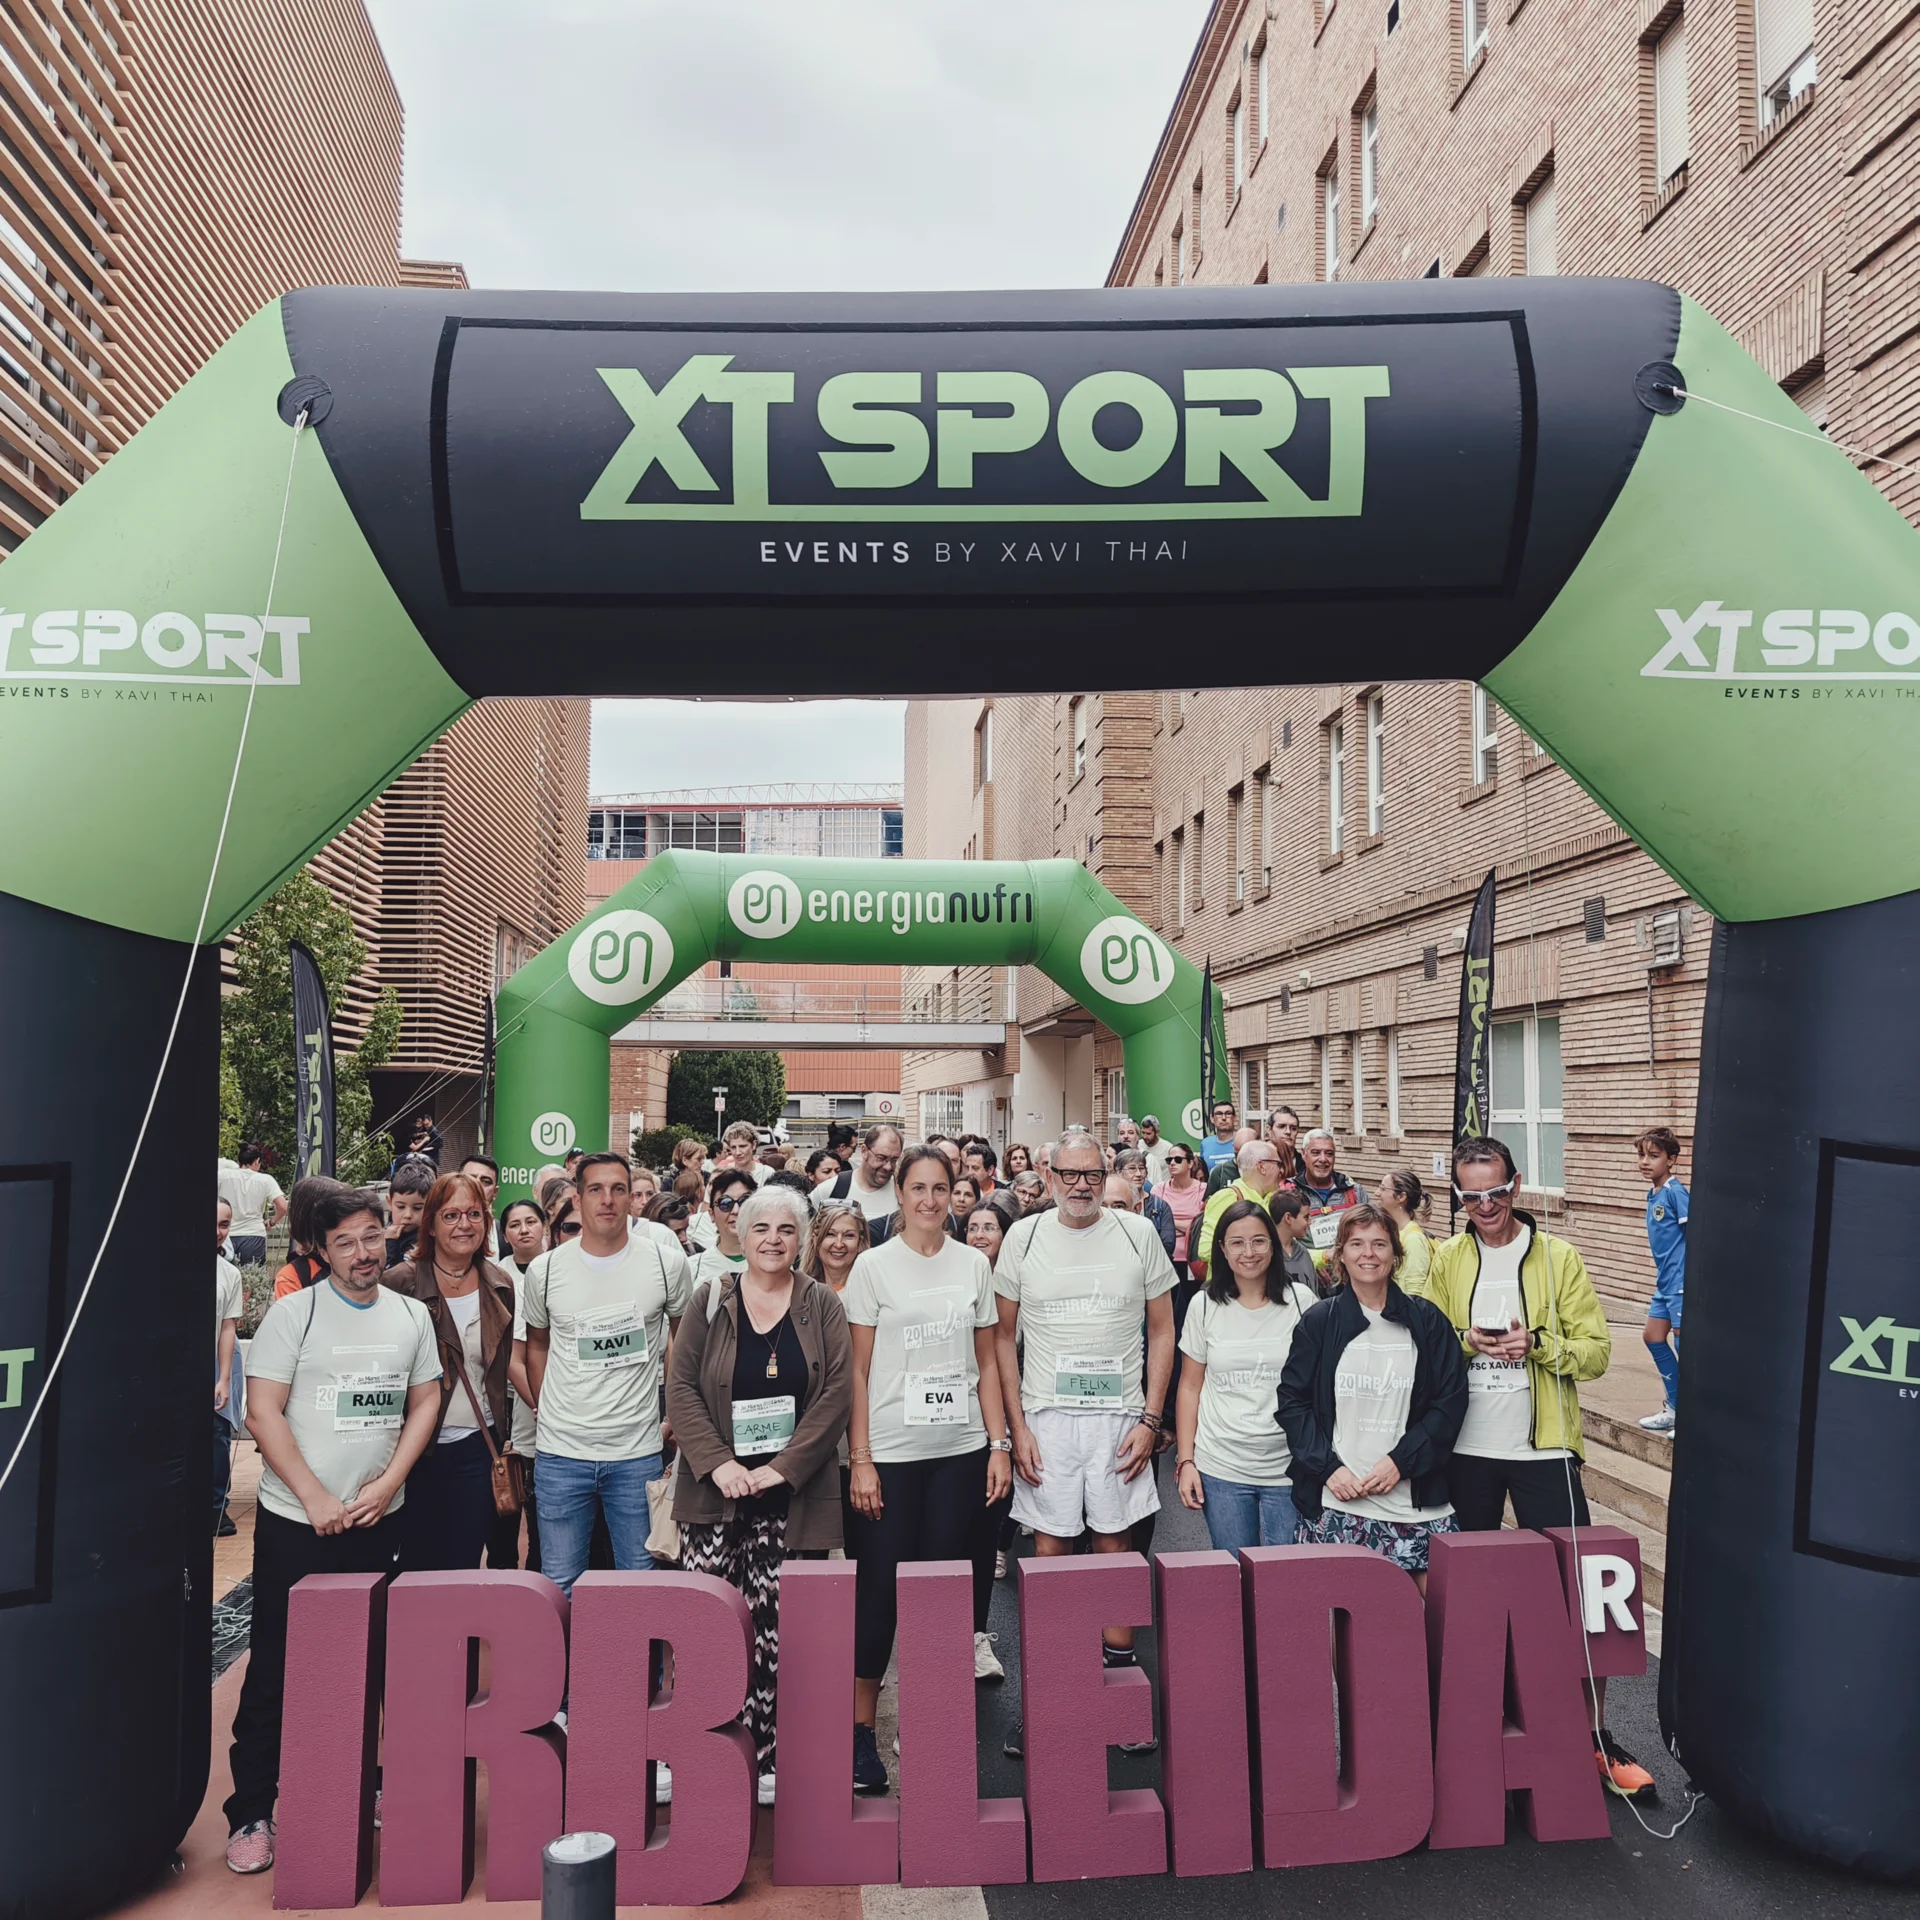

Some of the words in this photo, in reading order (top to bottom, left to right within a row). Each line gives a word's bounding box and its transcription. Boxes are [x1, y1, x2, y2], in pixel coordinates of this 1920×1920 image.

[760, 541, 911, 564] EVENTS
[934, 541, 976, 564] BY
[1001, 541, 1081, 564] XAVI
[1105, 540, 1188, 563] THAI
[0, 686, 70, 699] EVENTS
[81, 688, 102, 699] BY
[115, 689, 157, 701] XAVI
[170, 691, 214, 703] THAI
[1725, 687, 1801, 699] EVENTS
[1812, 688, 1835, 699] BY
[1845, 688, 1885, 699] XAVI
[1896, 688, 1920, 699] TH
[592, 1335, 631, 1351] XAVI
[1339, 1374, 1355, 1390] 20
[318, 1387, 336, 1402] 20
[352, 1391, 394, 1407] RAÜL
[925, 1391, 954, 1404] EVA
[734, 1422, 782, 1436] CARME
